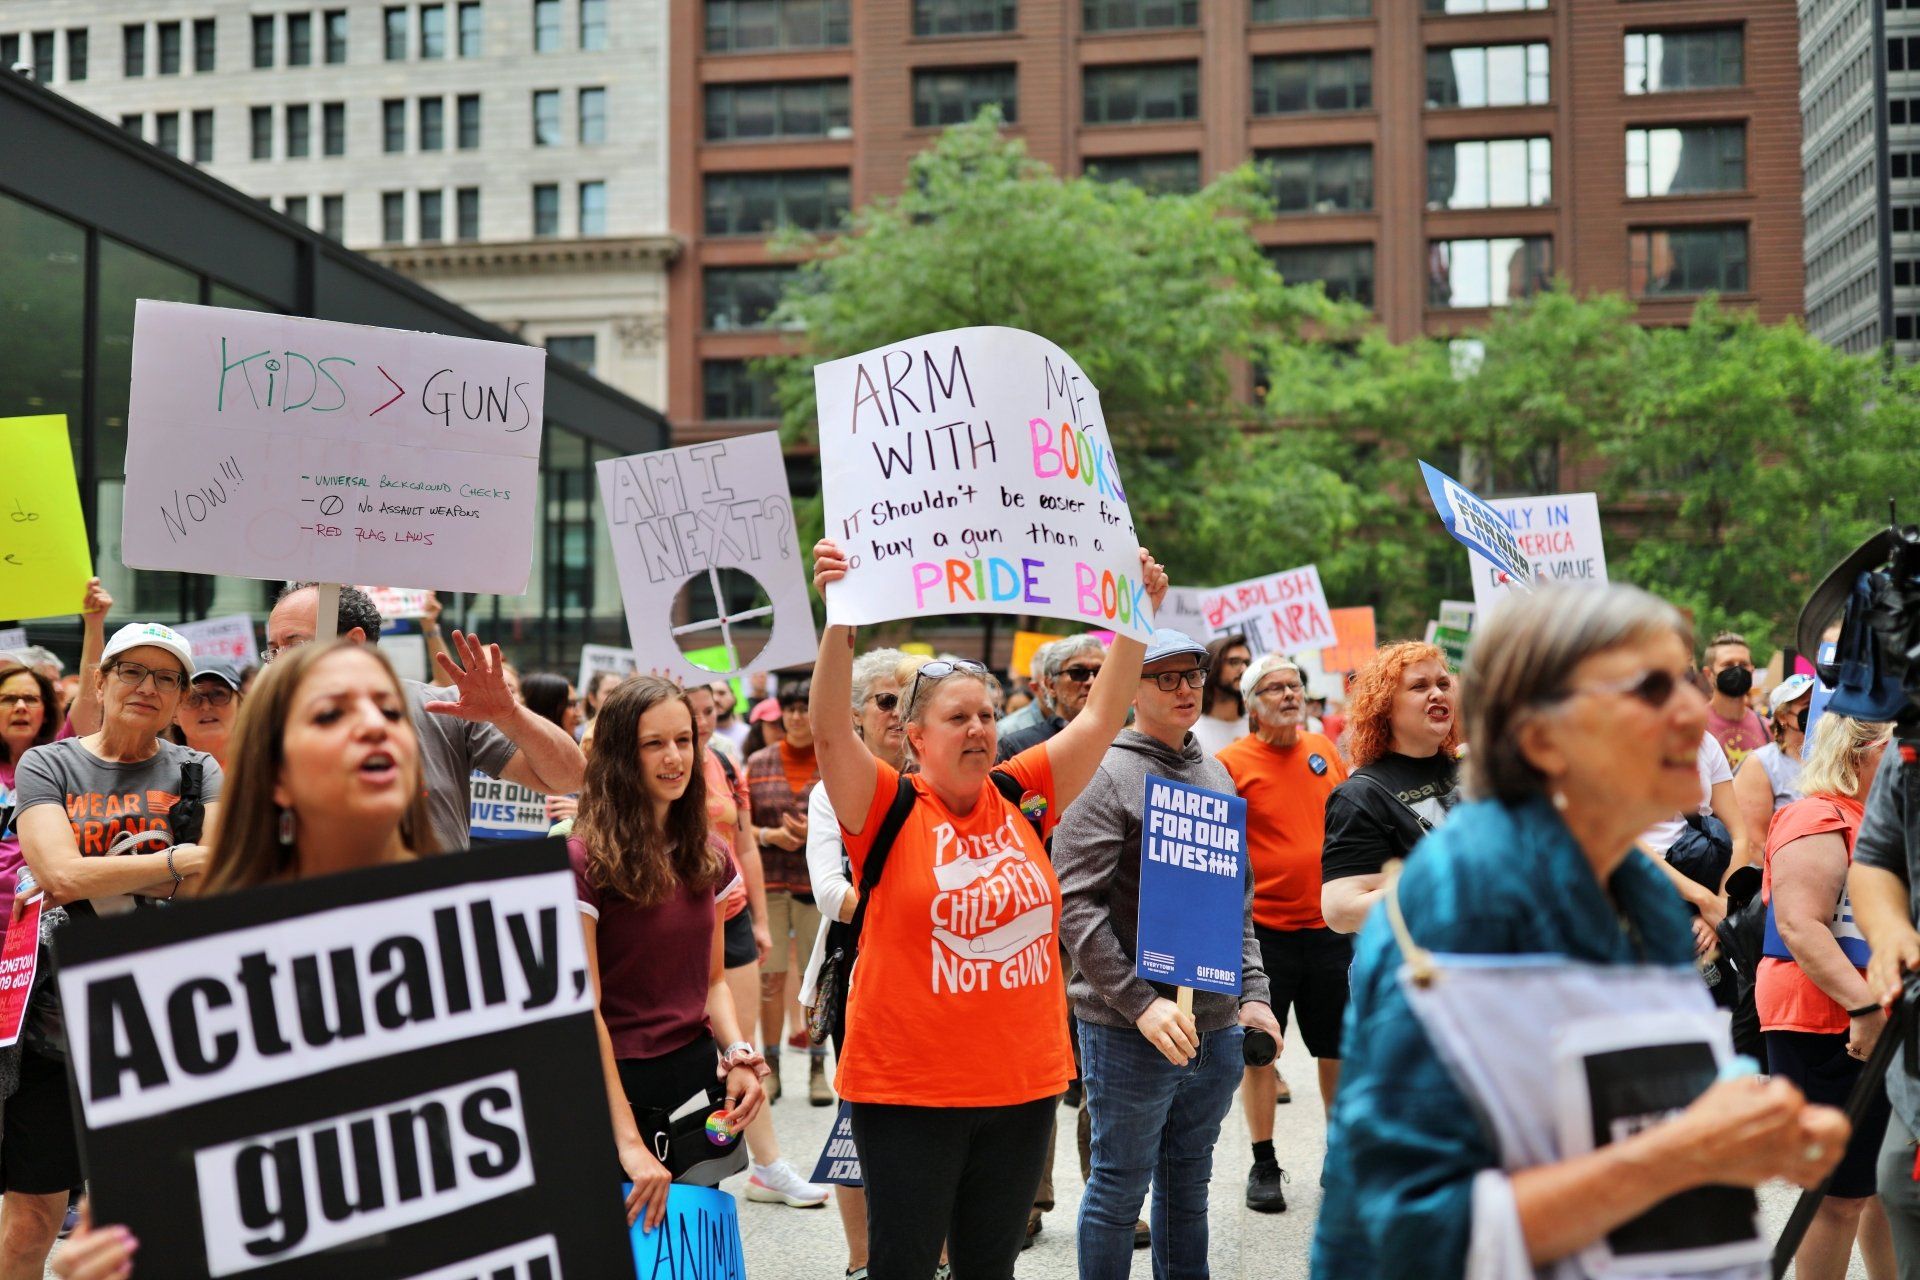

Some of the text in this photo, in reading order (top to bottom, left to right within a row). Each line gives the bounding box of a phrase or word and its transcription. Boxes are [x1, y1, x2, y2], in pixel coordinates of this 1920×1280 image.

[422, 368, 530, 433] GUNS
[851, 345, 1094, 434] ARM ME
[872, 417, 1126, 503] WITH BOOKS
[160, 456, 245, 543] NOW!!!
[315, 475, 511, 500] UNIVERSAL BACKGROUND CHECKS
[613, 443, 735, 525] AM I
[378, 501, 425, 517] ASSAULT
[843, 509, 862, 540] IT
[1000, 485, 1025, 508] be
[1040, 493, 1085, 513] easier
[1098, 500, 1121, 526] for
[1453, 488, 1518, 547] MARCH
[1502, 504, 1570, 532] NLY IN
[394, 531, 435, 546] LAWS
[635, 494, 791, 584] NEXT?
[843, 522, 1104, 570] o buy a gun than a
[1458, 503, 1530, 575] FOR OUR
[1463, 516, 1514, 569] LIVES
[1519, 531, 1575, 557] ERICA
[1550, 558, 1597, 580] VALUE
[911, 557, 1154, 635] PRIDE BOOK
[1214, 571, 1315, 615] ABOLISH
[1271, 601, 1330, 649] NRA
[66, 792, 141, 819] WEAR
[470, 781, 546, 804] OR OUR
[471, 802, 516, 822] IVES
[1151, 784, 1229, 824] MARCH
[1148, 836, 1208, 872] LIVES
[1149, 810, 1240, 852] FOR OUR
[0, 970, 31, 990] STOP GU
[1000, 935, 1053, 990] GUNS
[1196, 965, 1236, 983] GIFFORDS
[86, 899, 588, 1105] Actually,
[233, 1086, 524, 1258] guns
[827, 1161, 862, 1179] RCH
